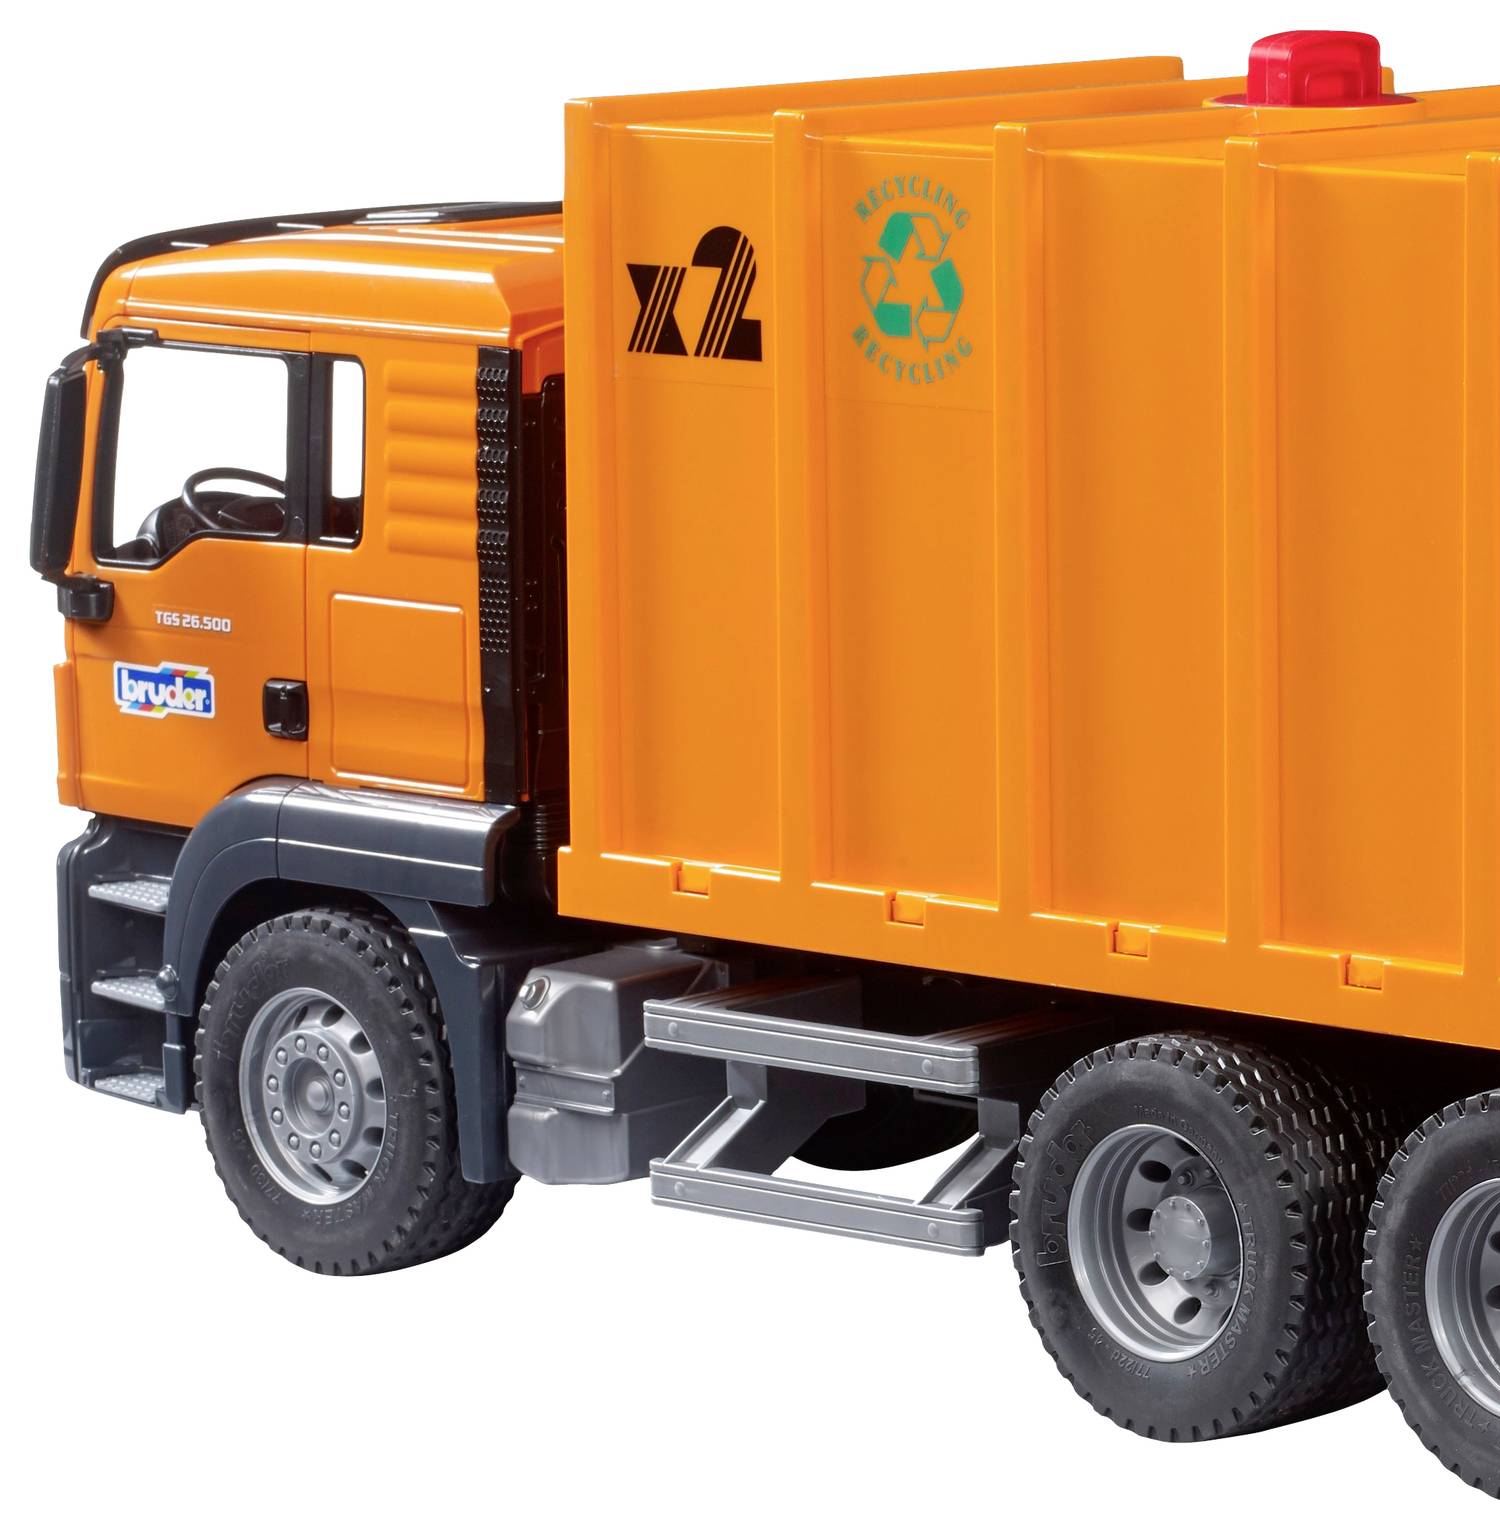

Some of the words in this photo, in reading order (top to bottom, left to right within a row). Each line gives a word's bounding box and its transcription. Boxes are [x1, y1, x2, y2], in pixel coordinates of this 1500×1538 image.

[854, 175, 971, 231] RECYCLING
[851, 324, 973, 385] RECYCLING
[154, 609, 180, 627] TGS
[182, 613, 232, 633] 26.500
[121, 668, 207, 712] bruder
[1036, 1119, 1094, 1268] bruder
[1241, 1216, 1259, 1303] TRUCK
[1403, 1253, 1425, 1354] MASTER
[1200, 1301, 1253, 1378] MASTER
